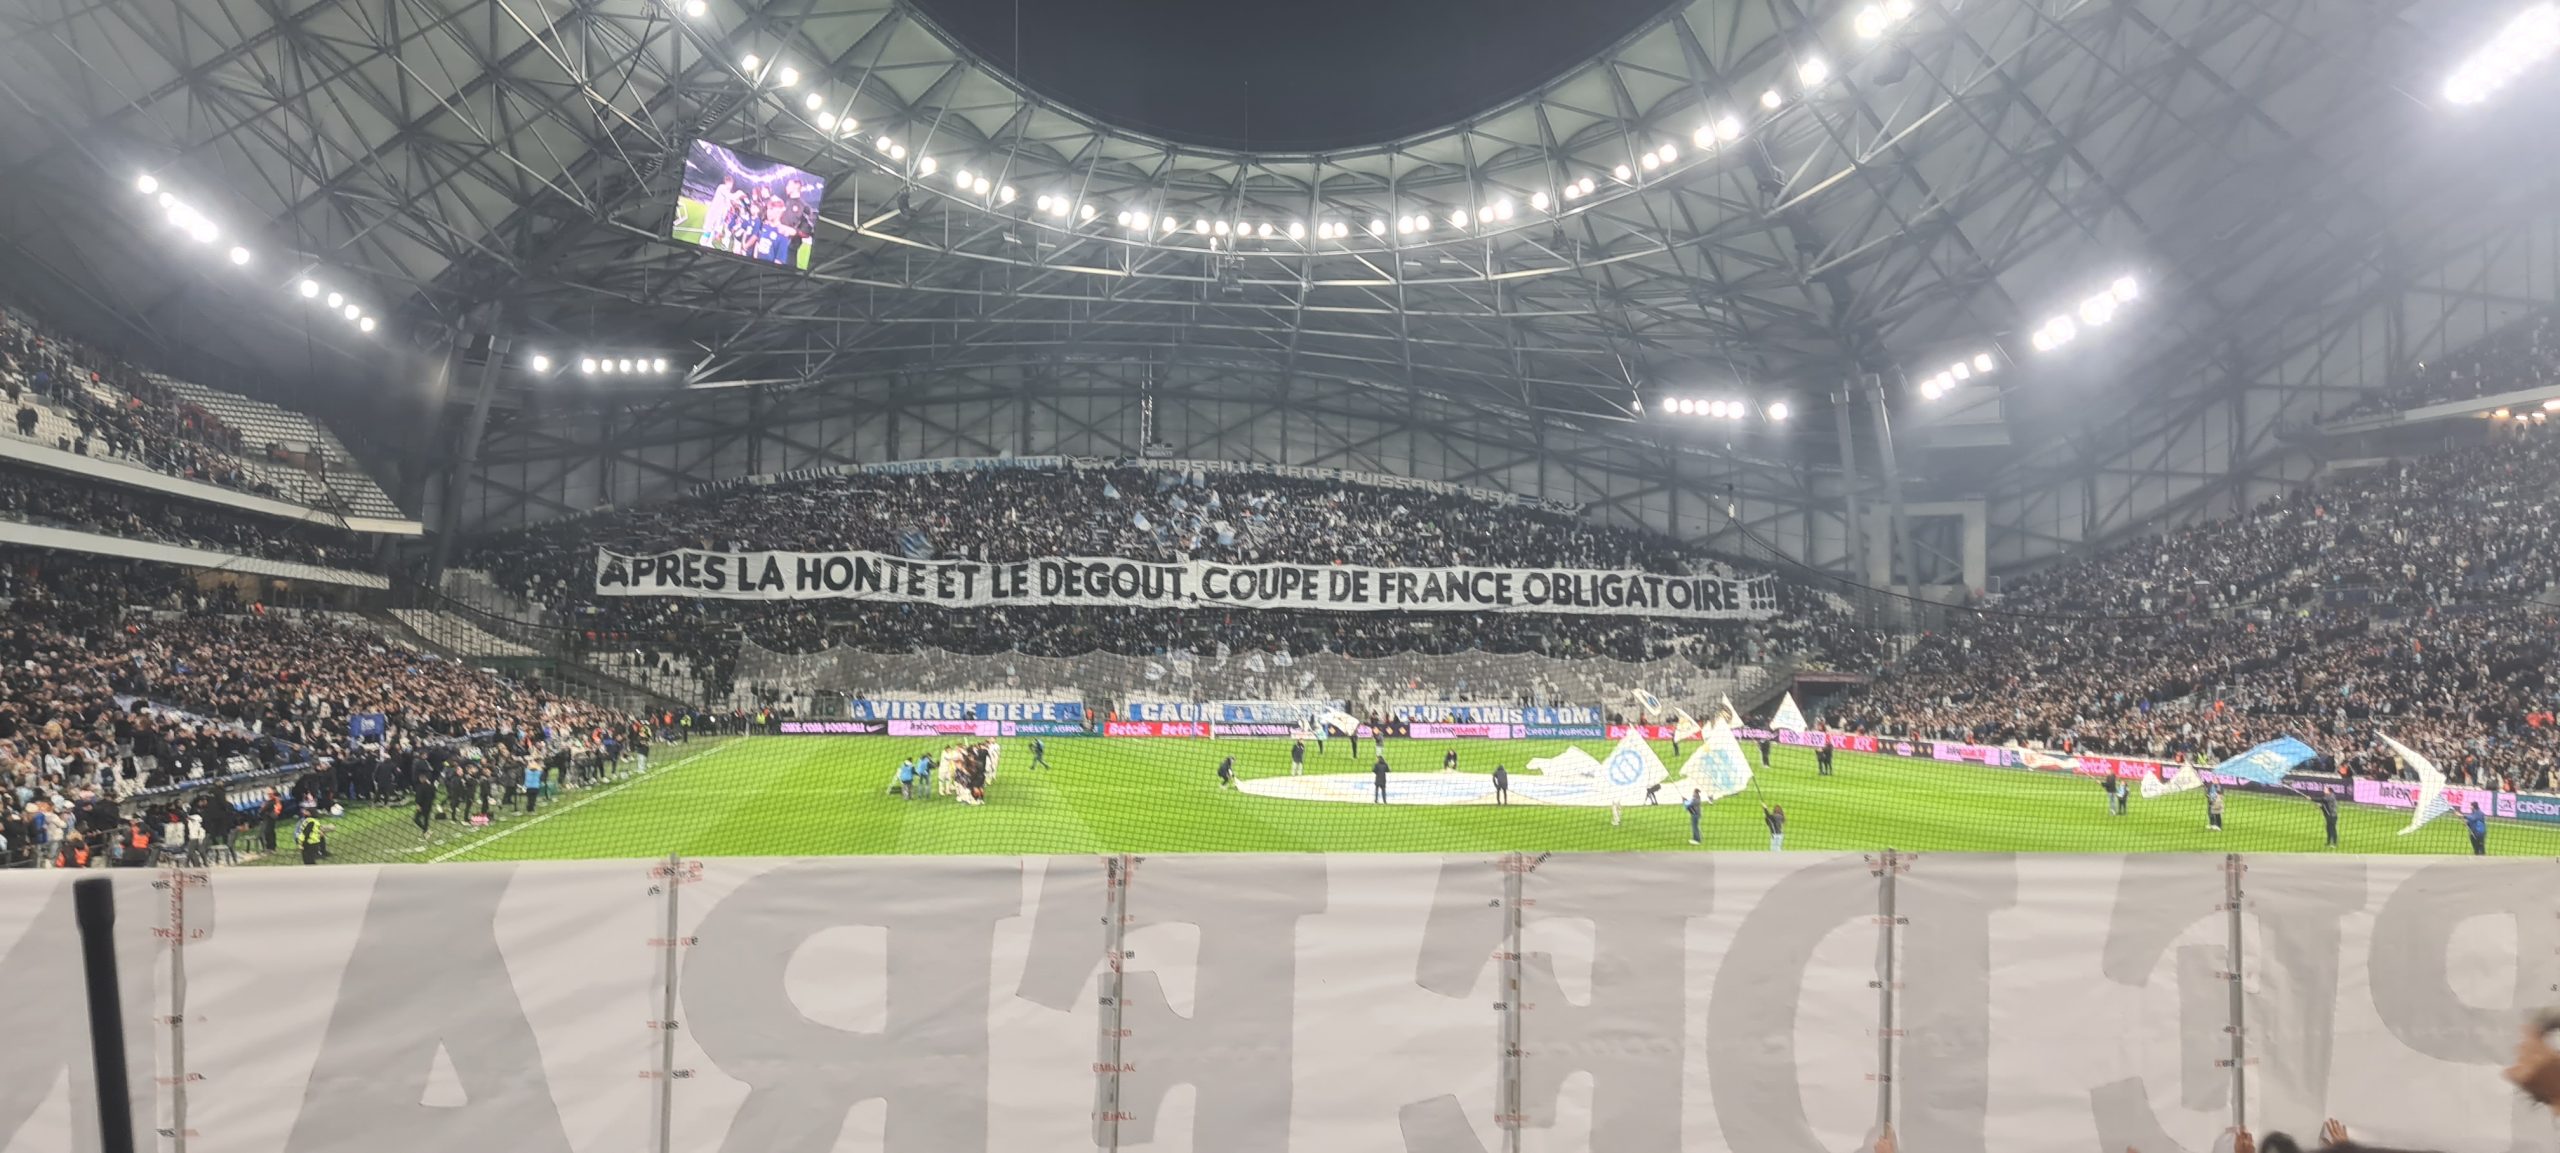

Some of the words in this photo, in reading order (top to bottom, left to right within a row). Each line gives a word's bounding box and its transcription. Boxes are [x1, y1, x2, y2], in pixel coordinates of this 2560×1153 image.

[1341, 469, 1457, 496] PUISSANT
[738, 555, 784, 591] LA
[797, 556, 926, 597] HONTE
[937, 564, 981, 600] ET
[991, 563, 1029, 598] LE
[1202, 566, 1318, 600] COUPE
[1328, 570, 1369, 603] DE
[1379, 571, 1513, 605] FRANCE
[1522, 572, 1740, 611] OBLIGATOIRE
[871, 701, 977, 719] VIRAGE
[1468, 706, 1524, 724] AMIS
